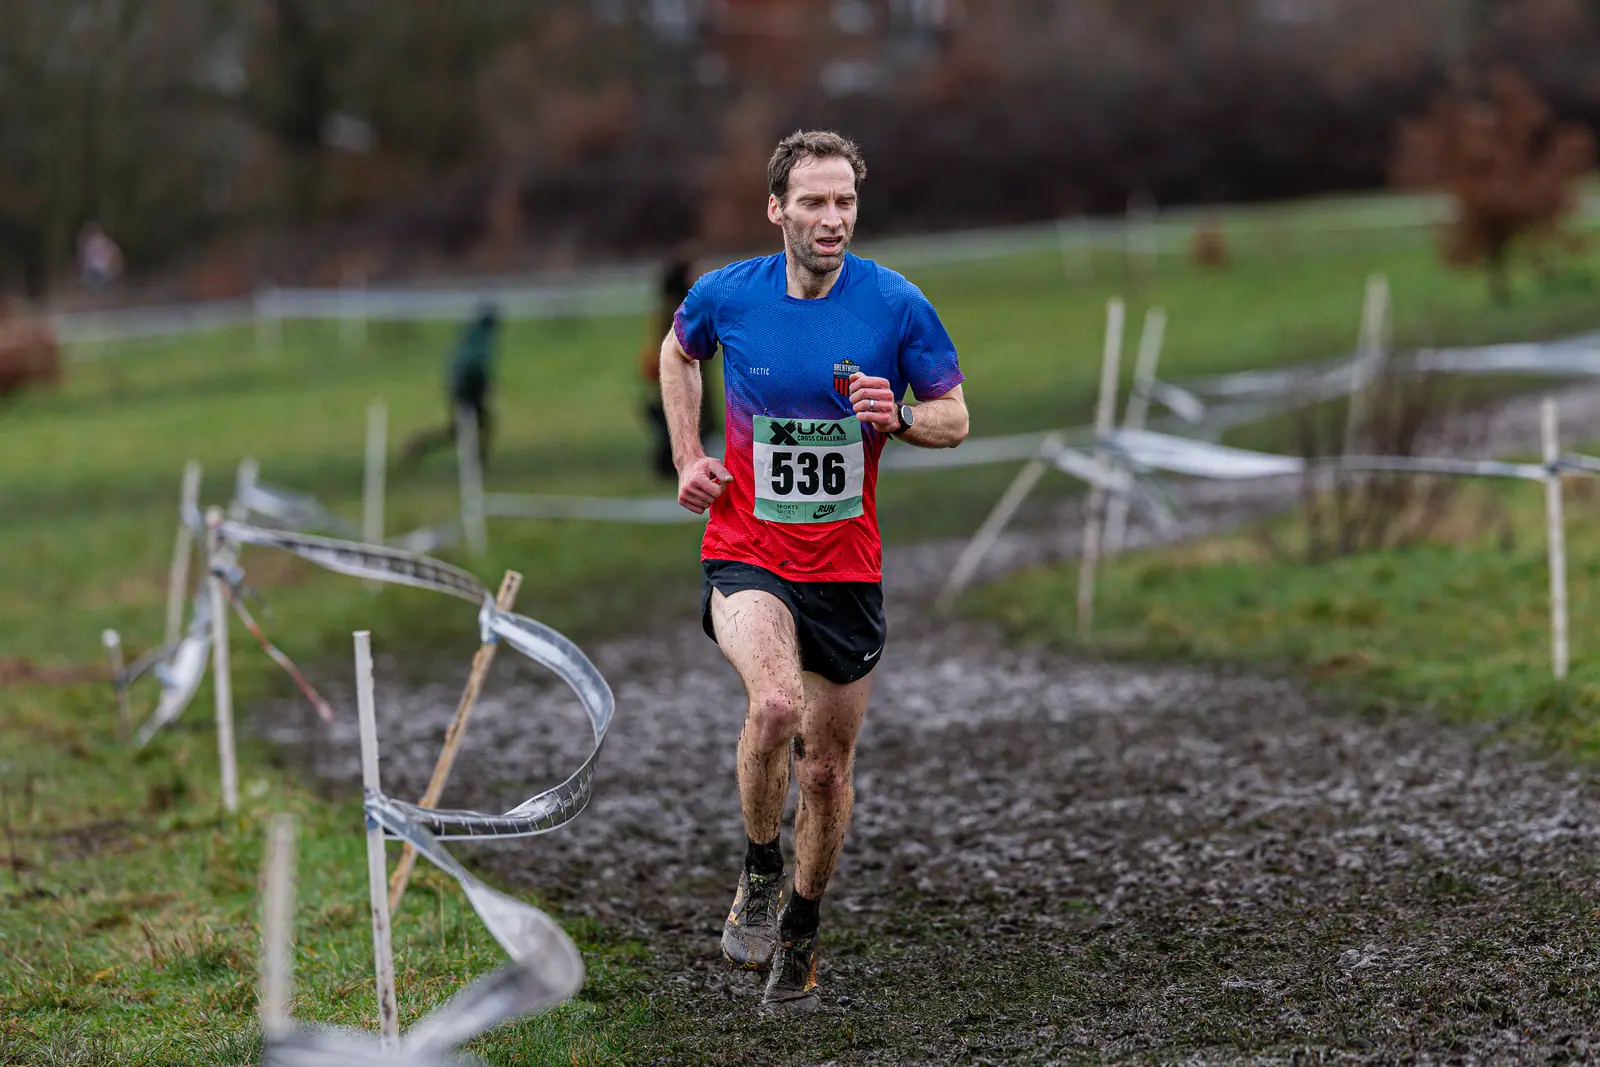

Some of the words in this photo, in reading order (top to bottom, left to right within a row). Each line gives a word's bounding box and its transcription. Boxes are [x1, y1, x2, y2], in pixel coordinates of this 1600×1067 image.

[750, 367, 770, 376] TACTIC
[797, 422, 846, 435] UKA
[816, 434, 847, 442] CHALLENGE
[771, 452, 846, 495] 536
[817, 504, 836, 513] RUN
